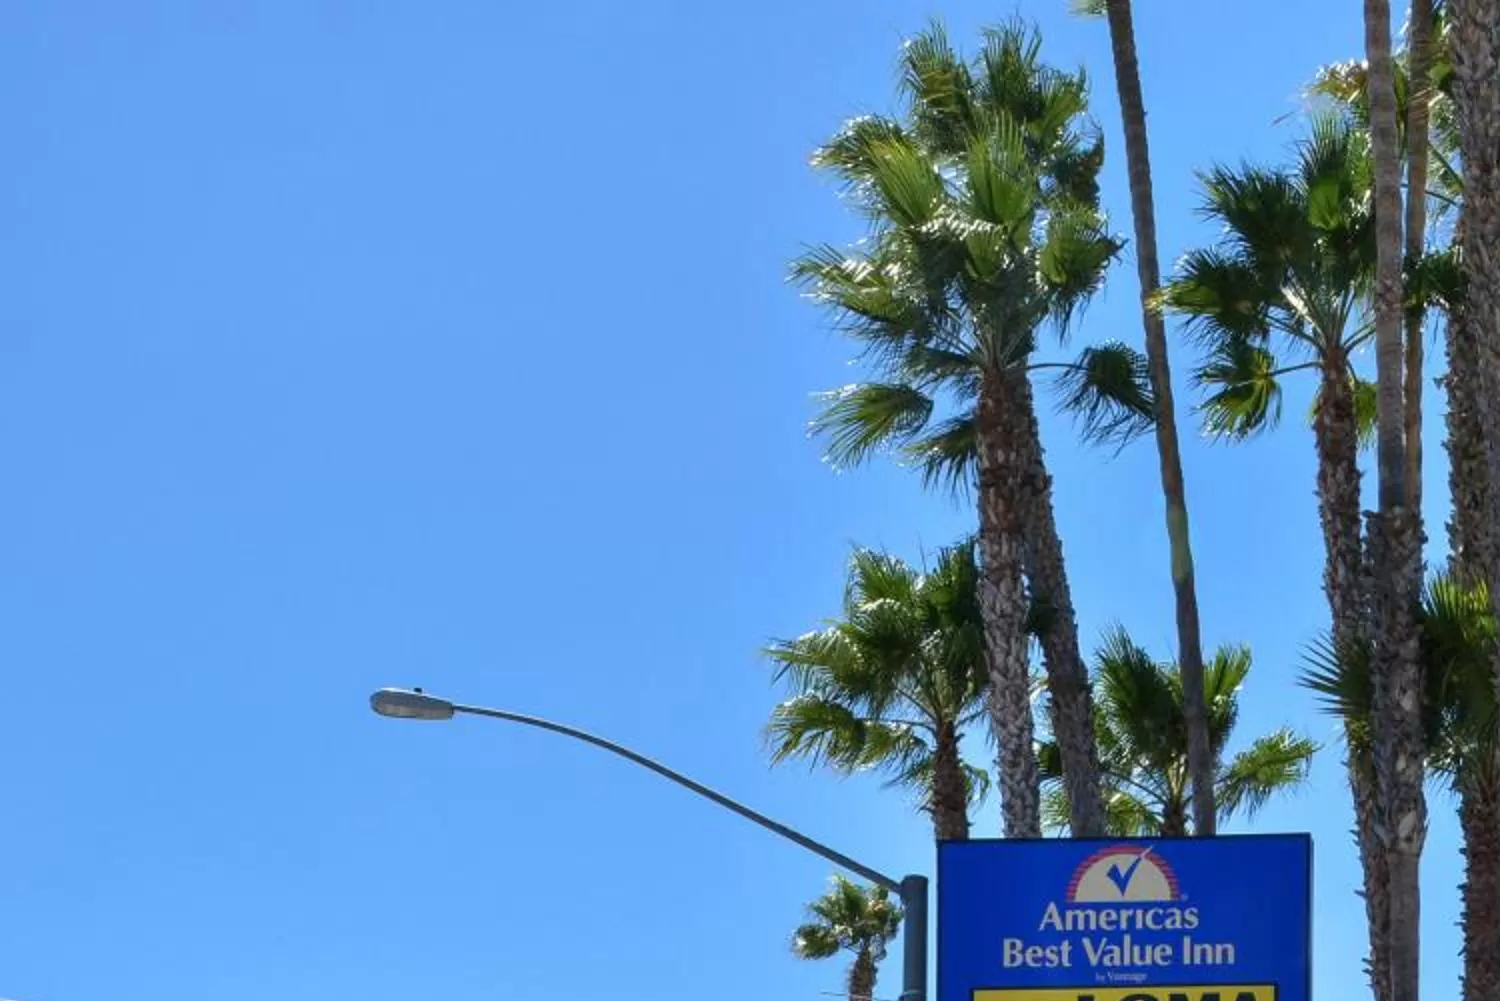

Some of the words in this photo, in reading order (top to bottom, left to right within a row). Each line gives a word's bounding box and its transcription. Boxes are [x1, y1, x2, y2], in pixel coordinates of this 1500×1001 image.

[1038, 901, 1200, 932] Americas
[1002, 937, 1073, 968] Best
[1081, 933, 1173, 967] Value
[1182, 935, 1236, 966] Inn
